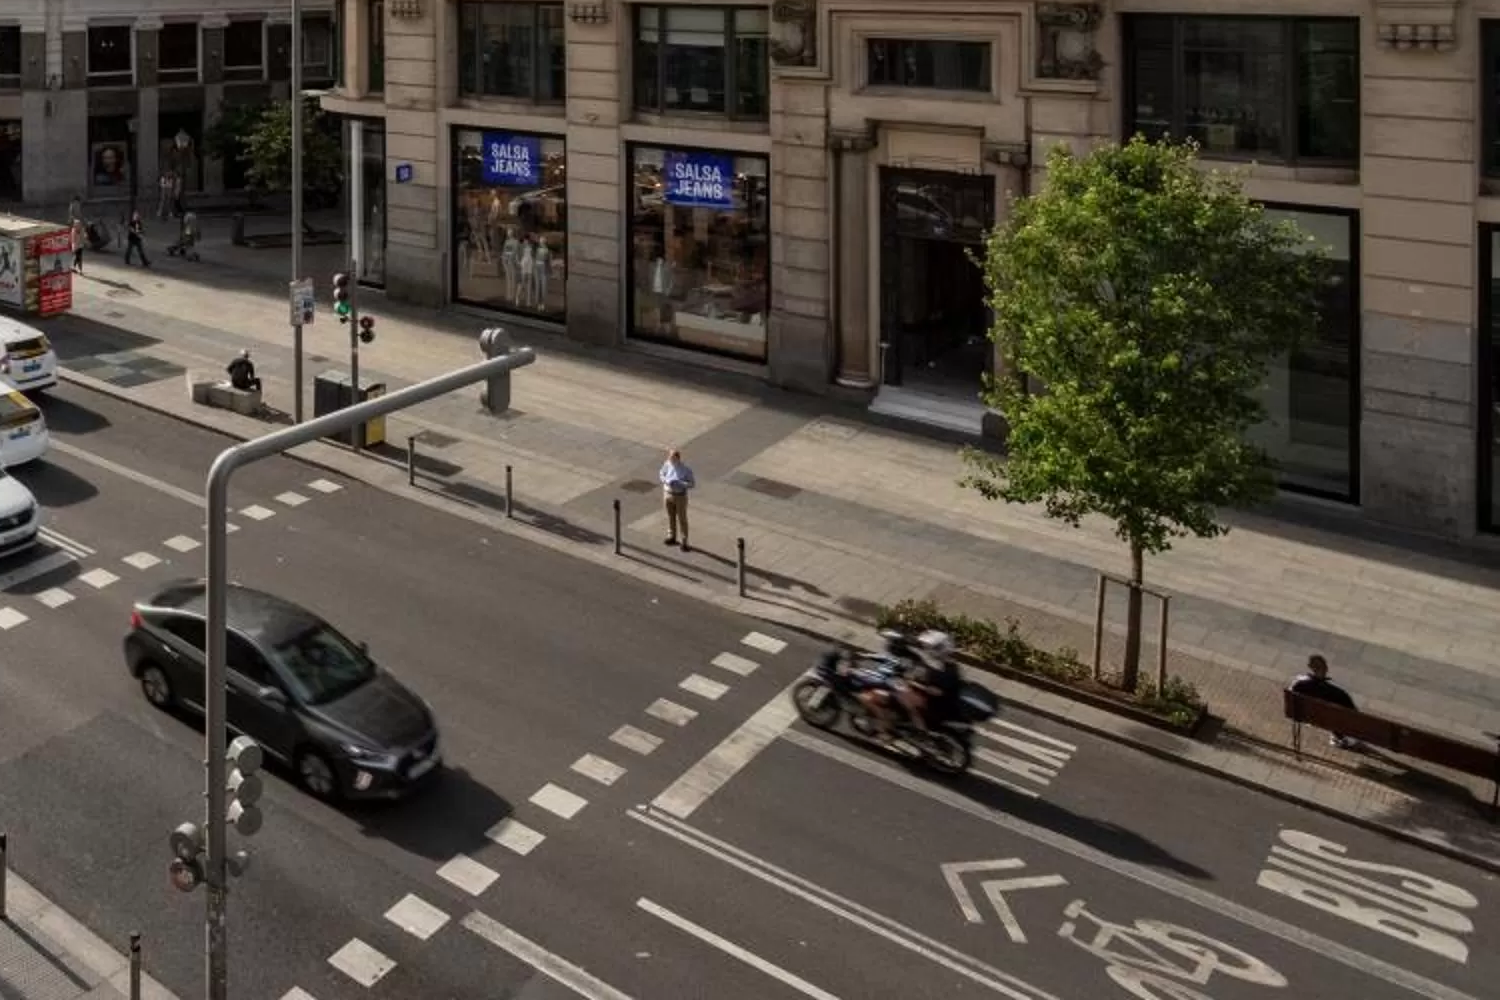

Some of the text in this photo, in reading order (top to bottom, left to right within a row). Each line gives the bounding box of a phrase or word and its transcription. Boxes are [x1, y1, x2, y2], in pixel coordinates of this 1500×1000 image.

[491, 143, 530, 161] SALSA
[491, 159, 531, 177] JEANS
[675, 162, 722, 182] SALSA
[675, 180, 723, 199] JEANS
[1256, 829, 1479, 964] BUS
